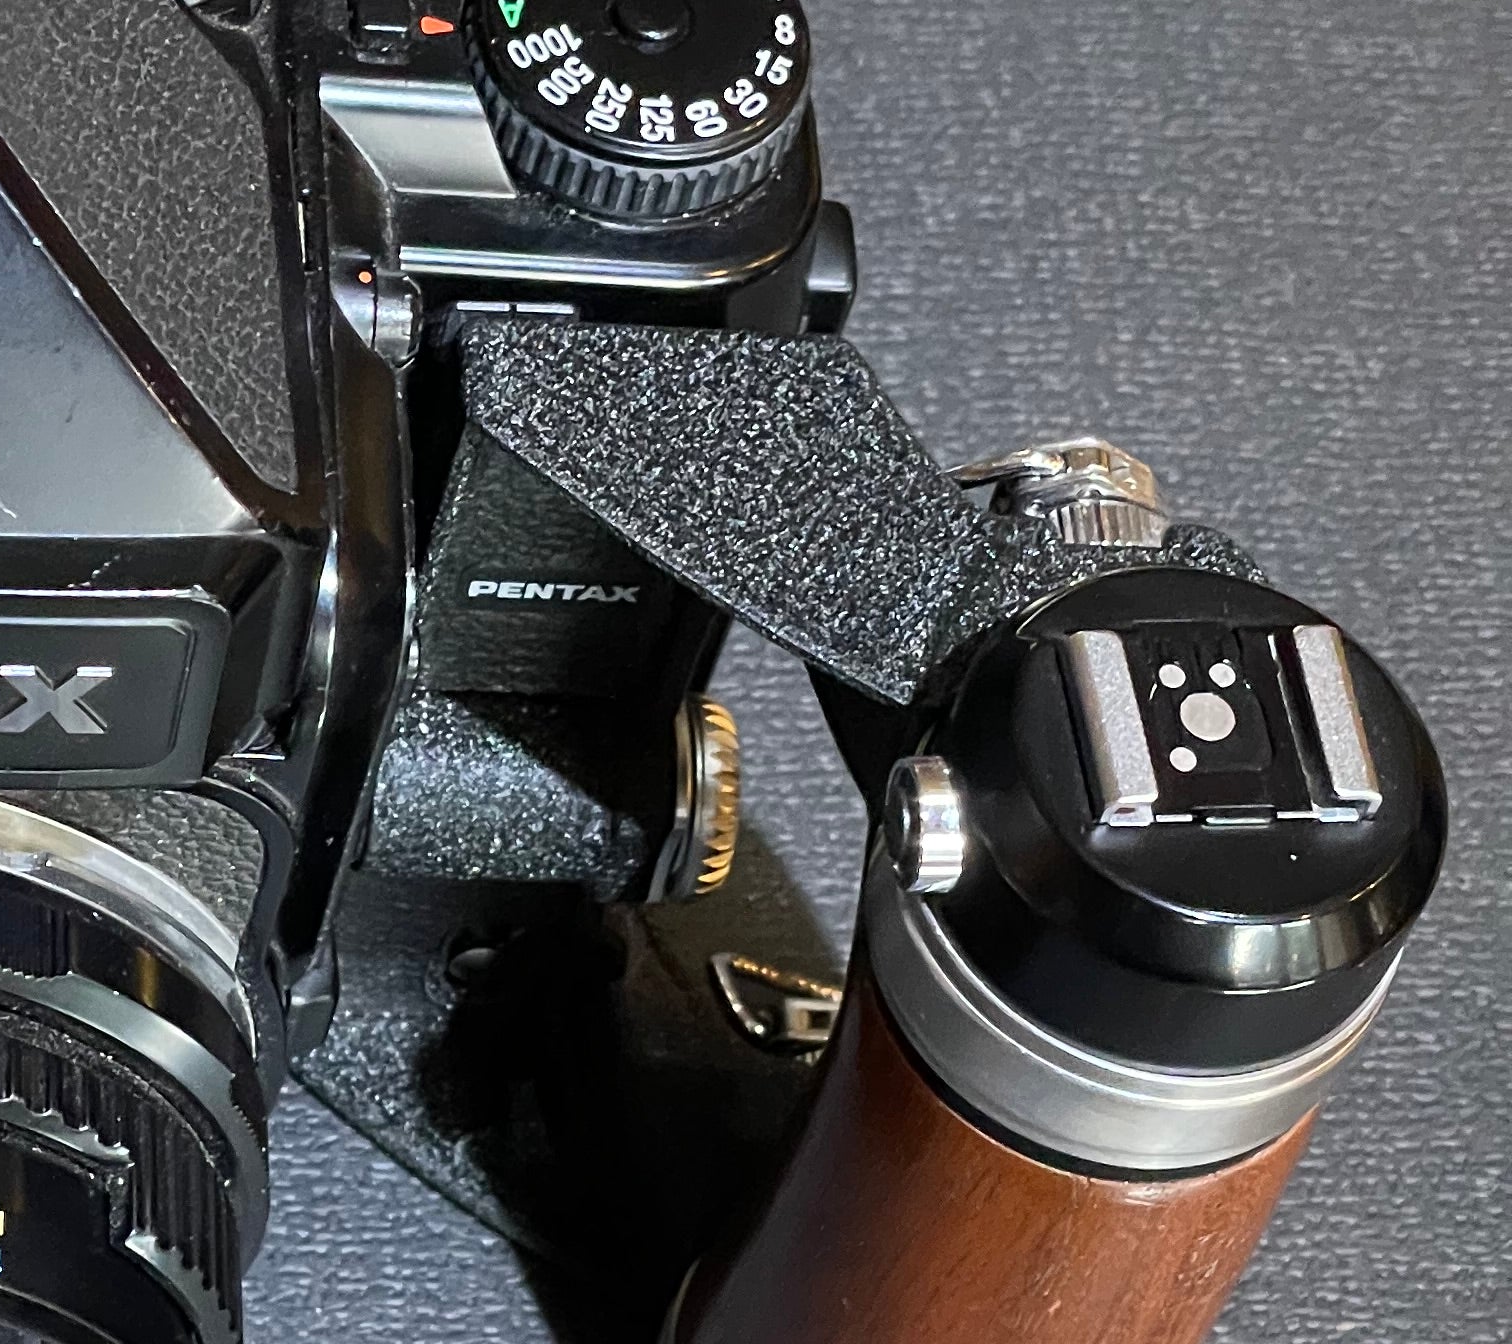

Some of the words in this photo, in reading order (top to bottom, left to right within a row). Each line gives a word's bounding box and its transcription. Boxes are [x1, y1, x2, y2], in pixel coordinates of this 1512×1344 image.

[507, 23, 584, 69] 1000
[774, 14, 796, 45] 8
[537, 56, 595, 106] 500
[754, 48, 793, 85] 15
[585, 77, 633, 133] 250
[685, 98, 728, 138] 60
[723, 78, 769, 118] 30
[639, 94, 676, 143] 125
[468, 580, 640, 603] PENTAX
